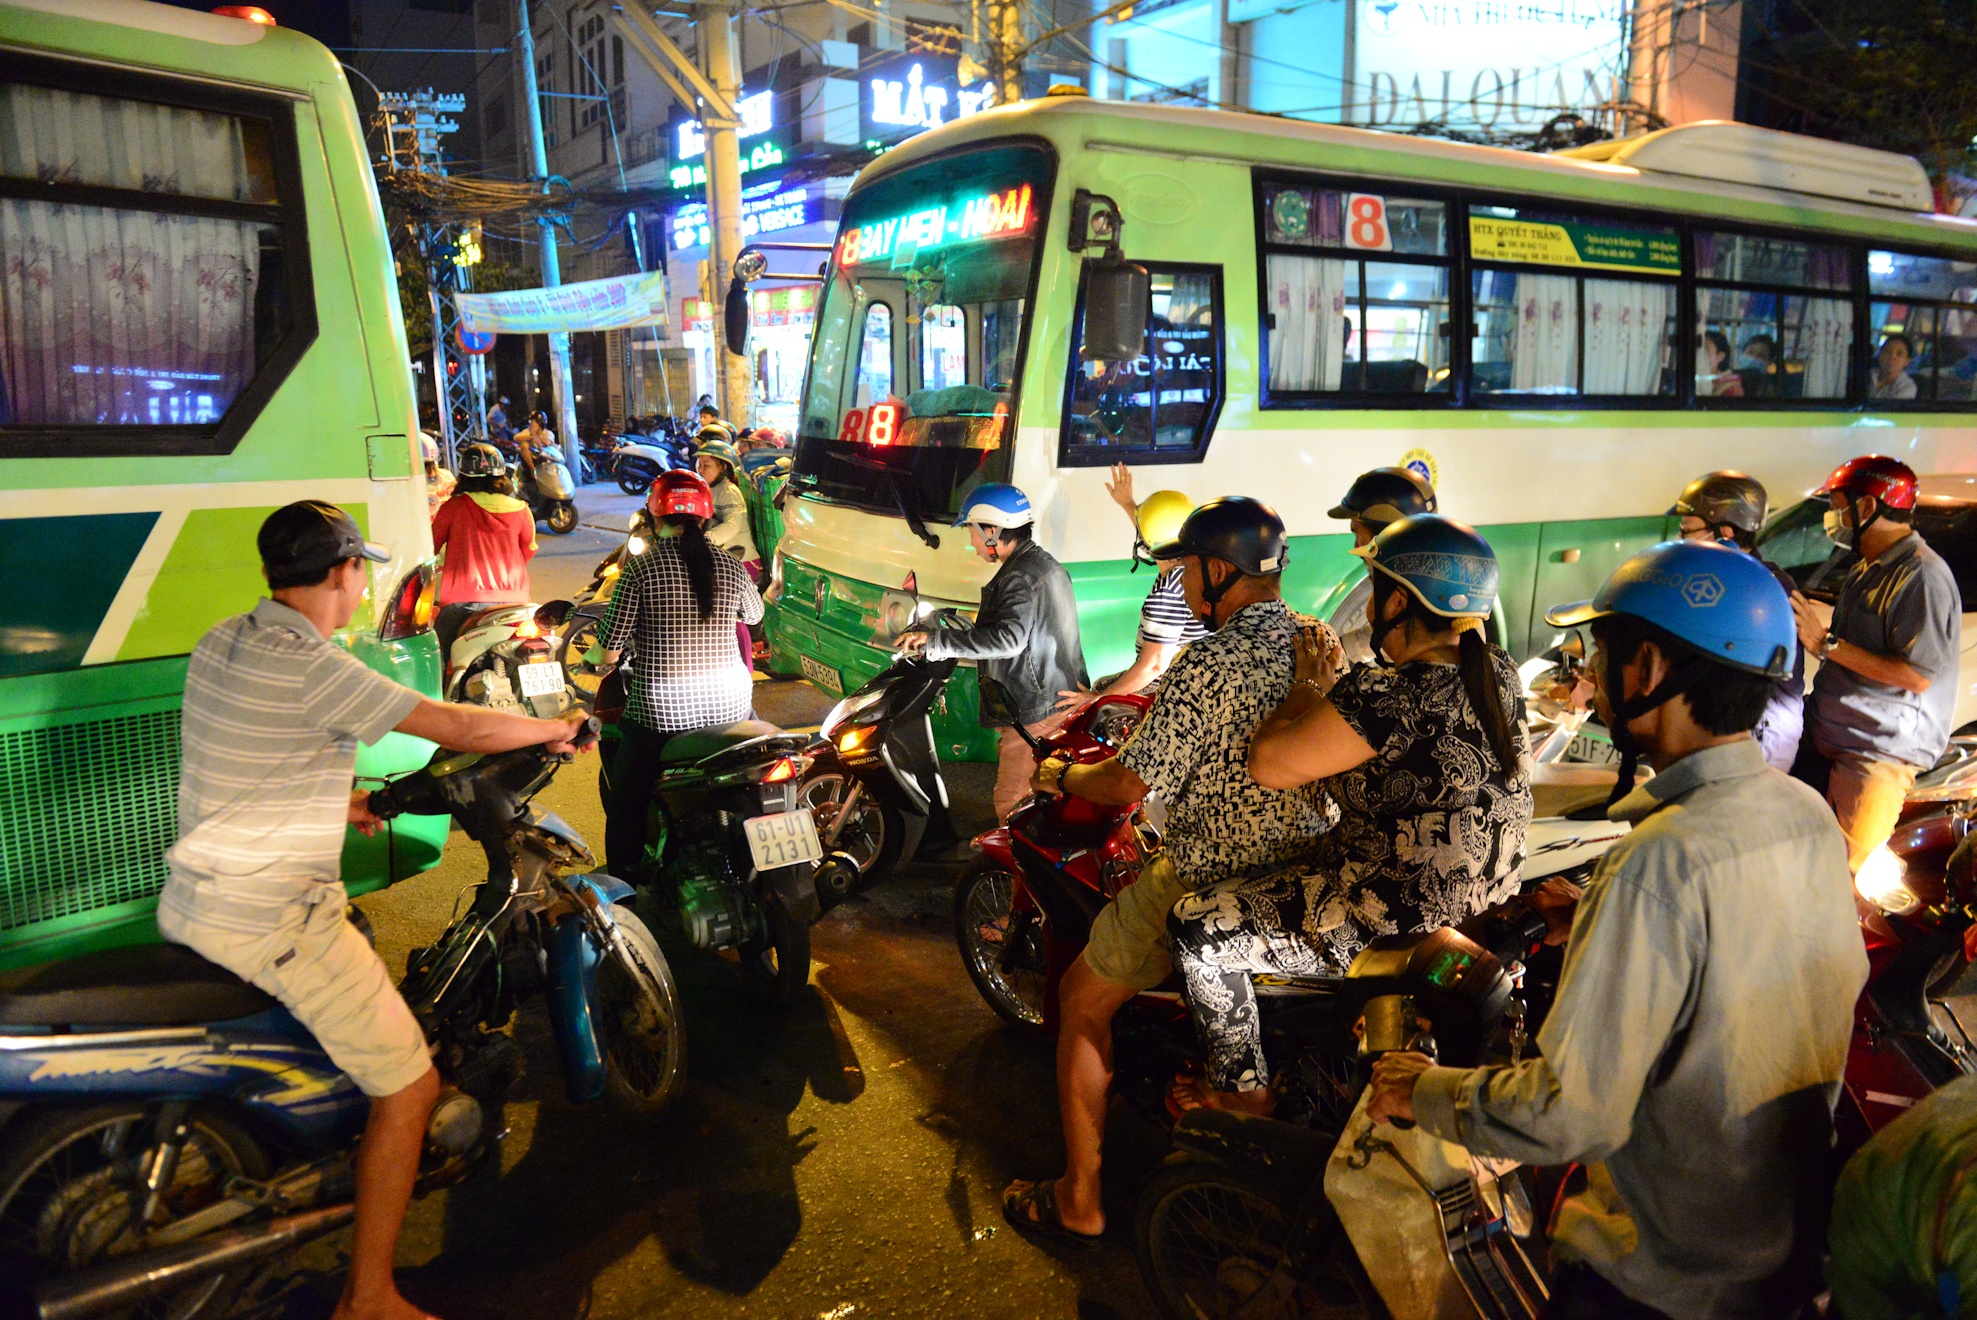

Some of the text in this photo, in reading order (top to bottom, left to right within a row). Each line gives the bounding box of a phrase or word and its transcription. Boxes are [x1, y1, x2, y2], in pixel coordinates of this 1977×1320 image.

[759, 204, 805, 232] VERSACE
[1352, 197, 1385, 248] 8
[841, 228, 862, 265] 8
[841, 410, 864, 442] 8
[869, 405, 895, 445] 8
[848, 755, 879, 766] HONDA
[756, 815, 805, 842] 61-U1
[762, 836, 811, 865] 2131
